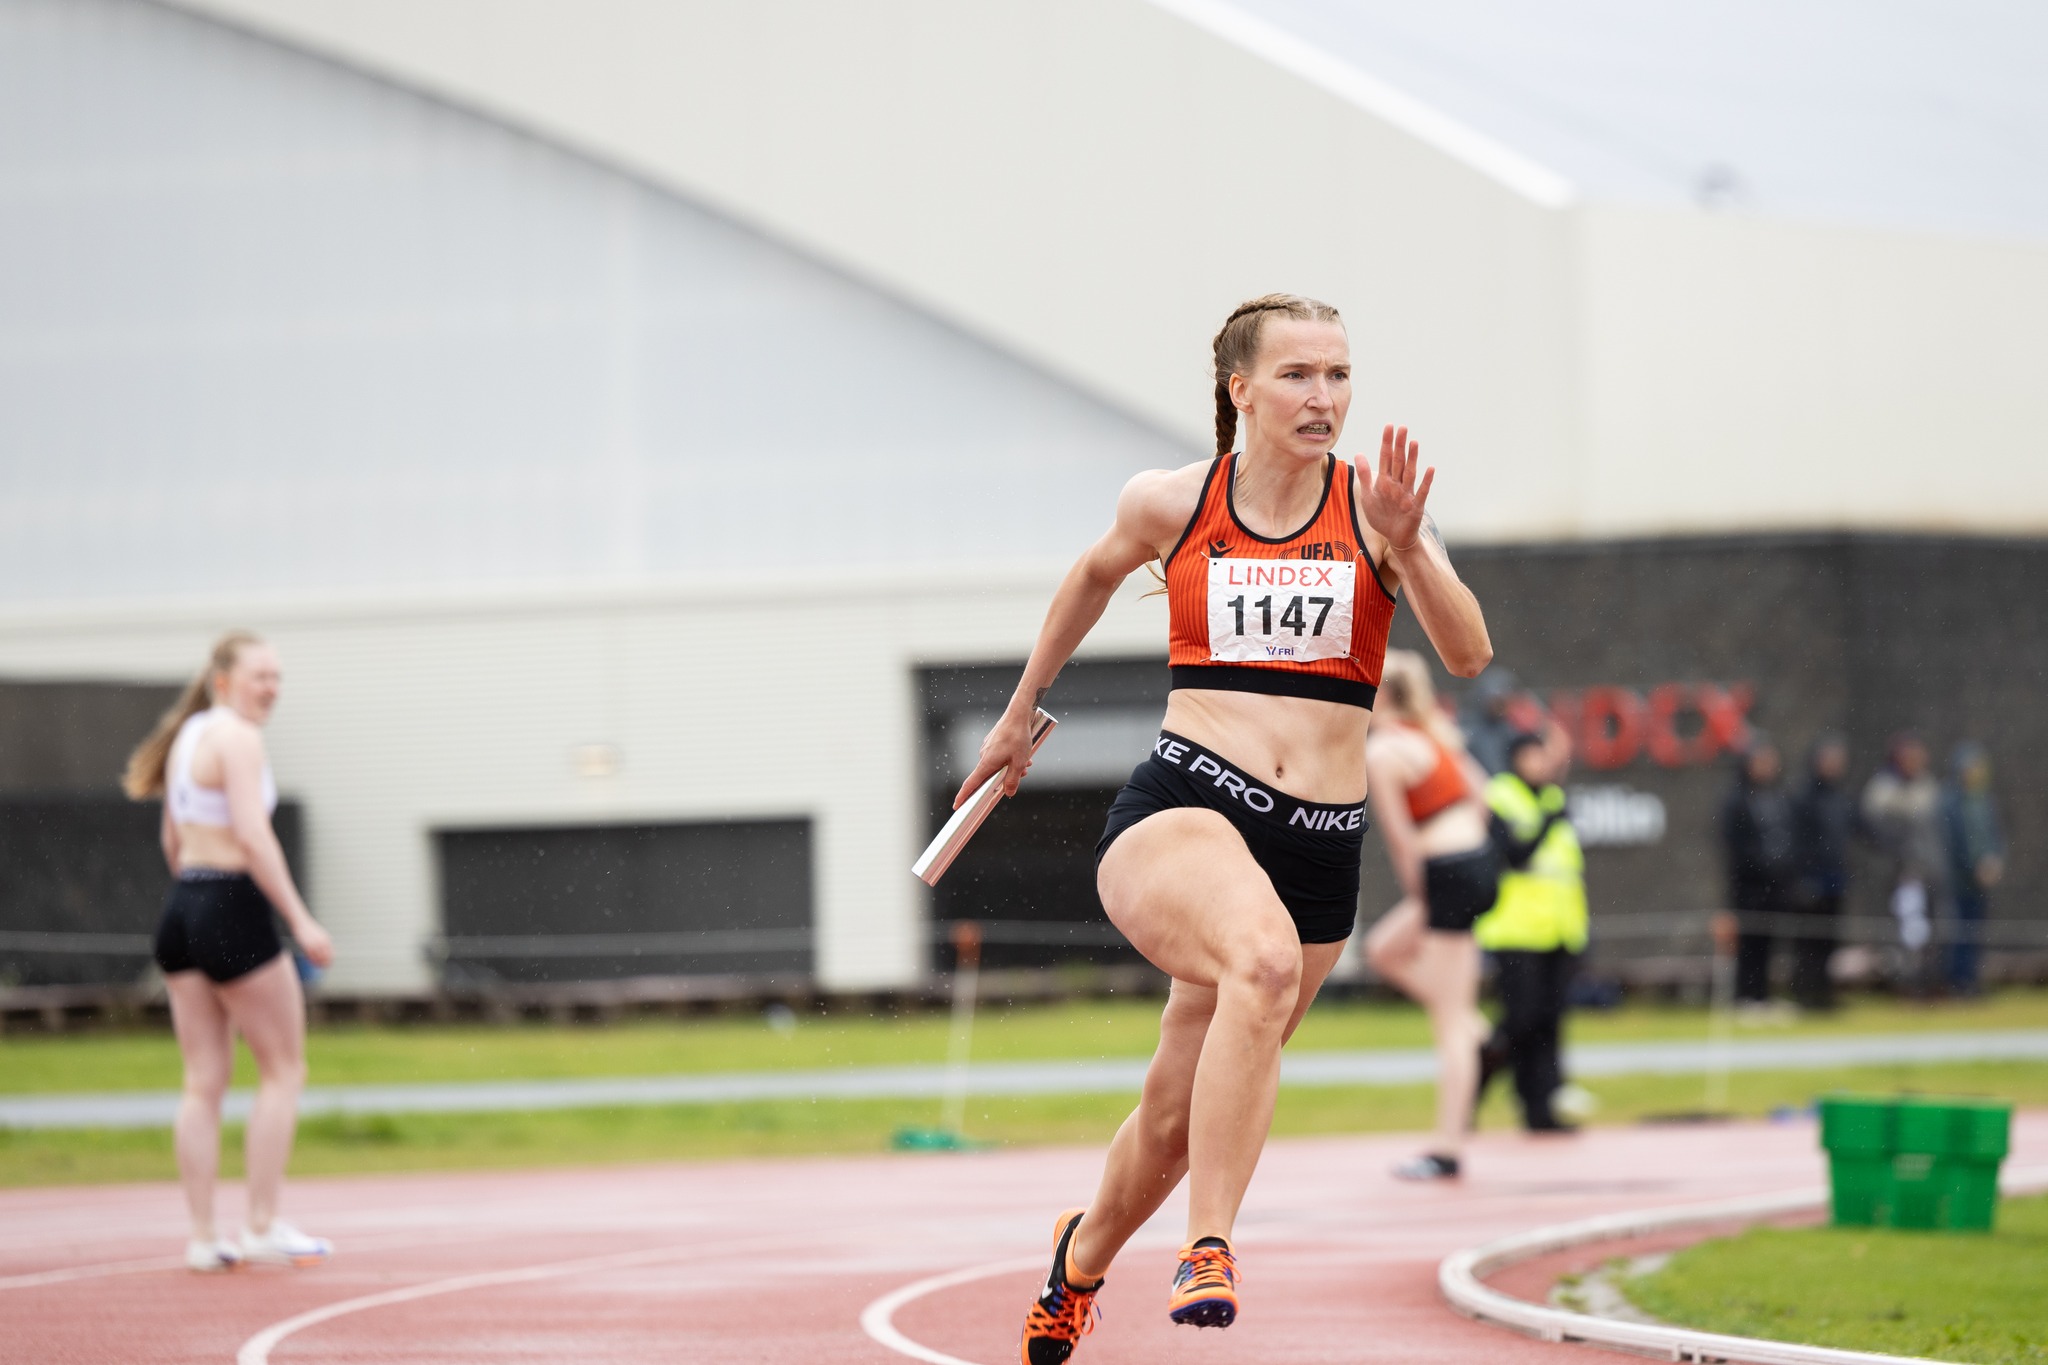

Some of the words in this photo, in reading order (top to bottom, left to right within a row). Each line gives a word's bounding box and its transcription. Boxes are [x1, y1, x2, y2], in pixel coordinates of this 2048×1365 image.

[1300, 541, 1335, 561] UFA
[1228, 565, 1334, 587] LINDEX
[1227, 594, 1335, 637] 1147
[1188, 753, 1275, 813] PRO
[1288, 806, 1364, 832] NIKE
